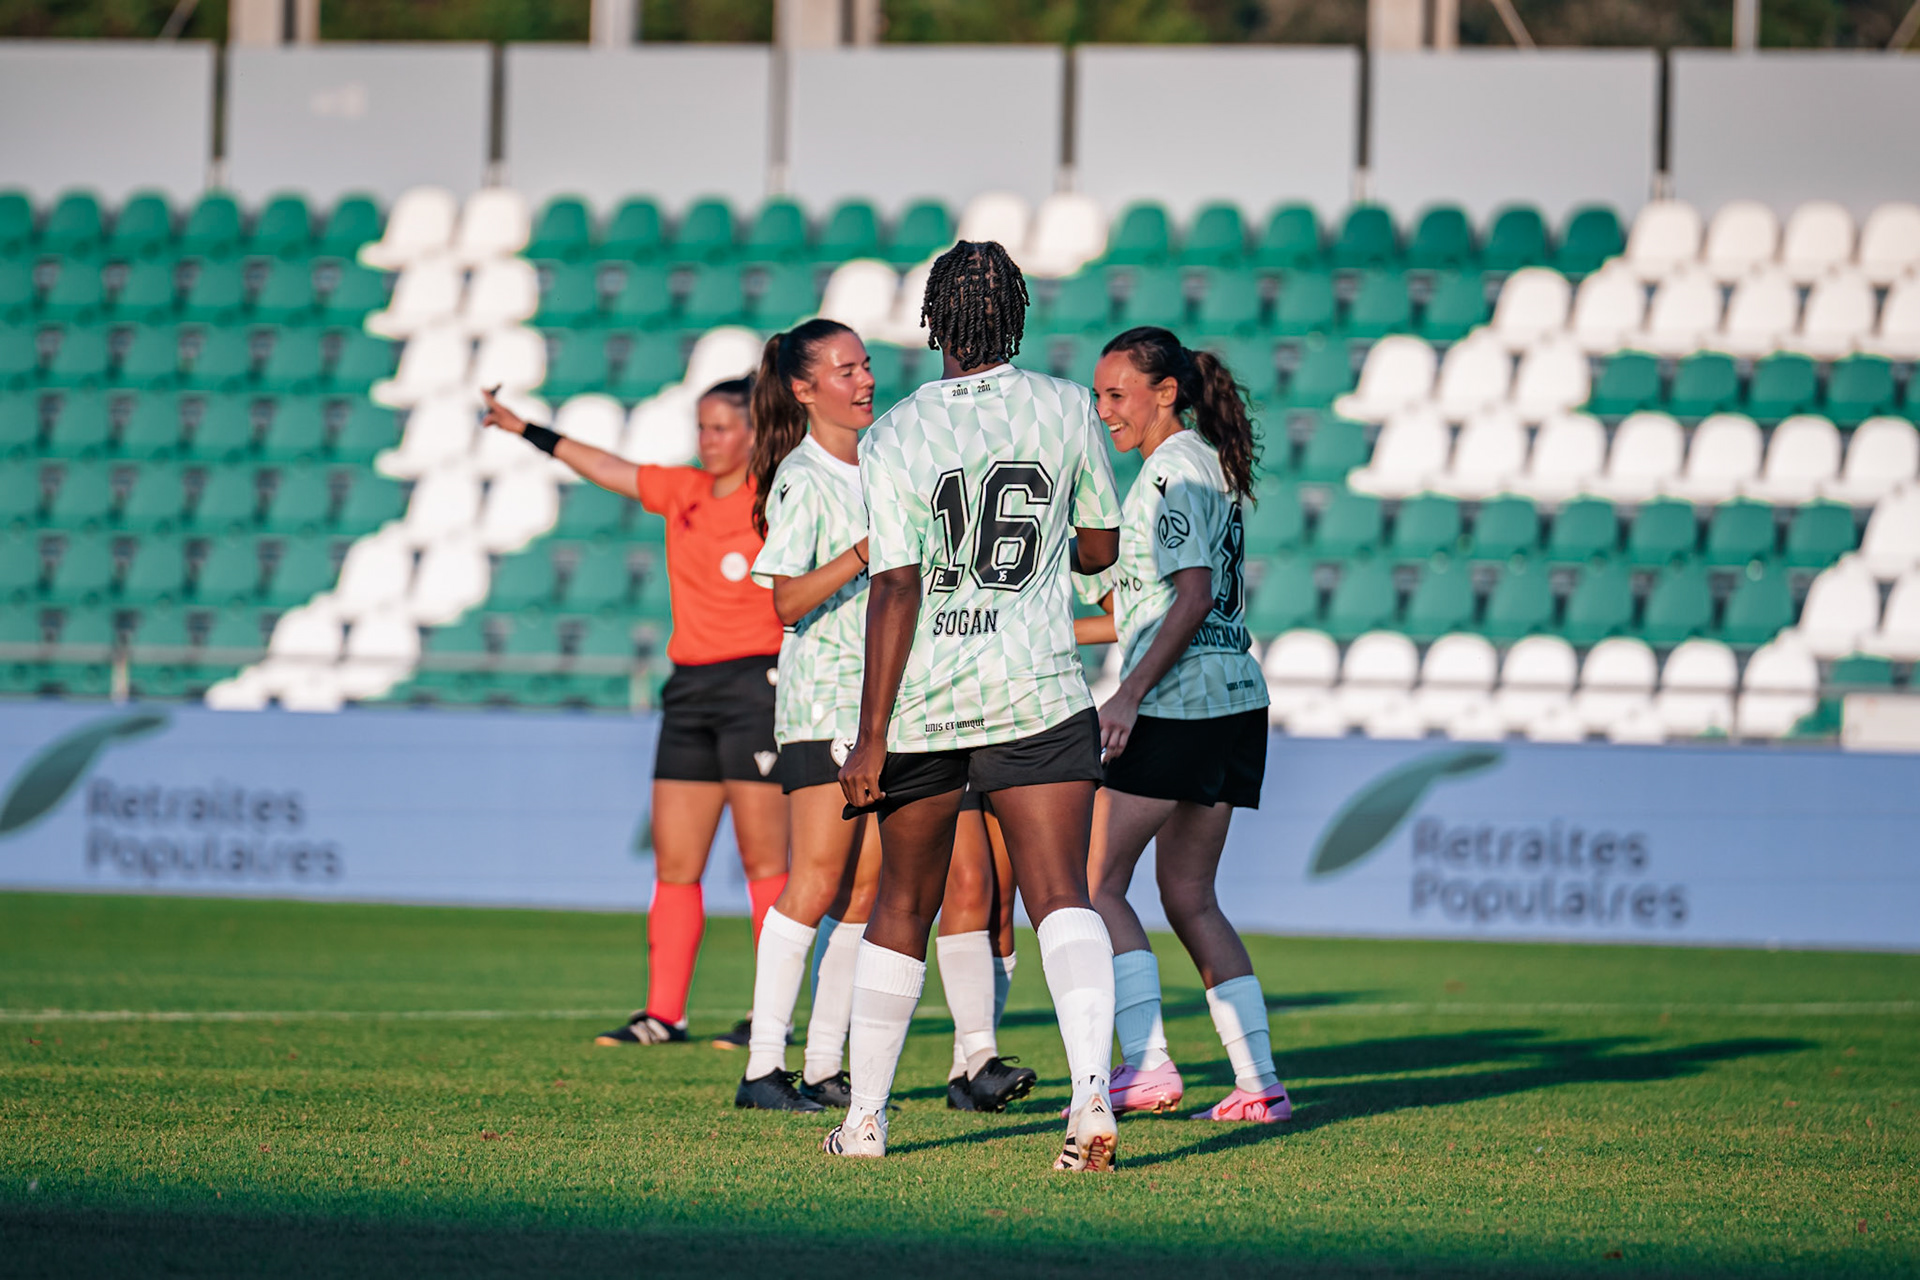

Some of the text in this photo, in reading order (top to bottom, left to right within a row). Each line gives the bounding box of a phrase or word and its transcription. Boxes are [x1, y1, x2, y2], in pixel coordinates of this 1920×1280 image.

[952, 383, 991, 397] 2010 2011
[927, 461, 1054, 595] 16
[932, 607, 999, 637] SOGAN
[945, 721, 955, 731] ET
[87, 779, 304, 831] Retraites
[86, 827, 343, 884] Populaires
[1412, 816, 1650, 871] Retraites
[1410, 867, 1690, 927] Populaires
